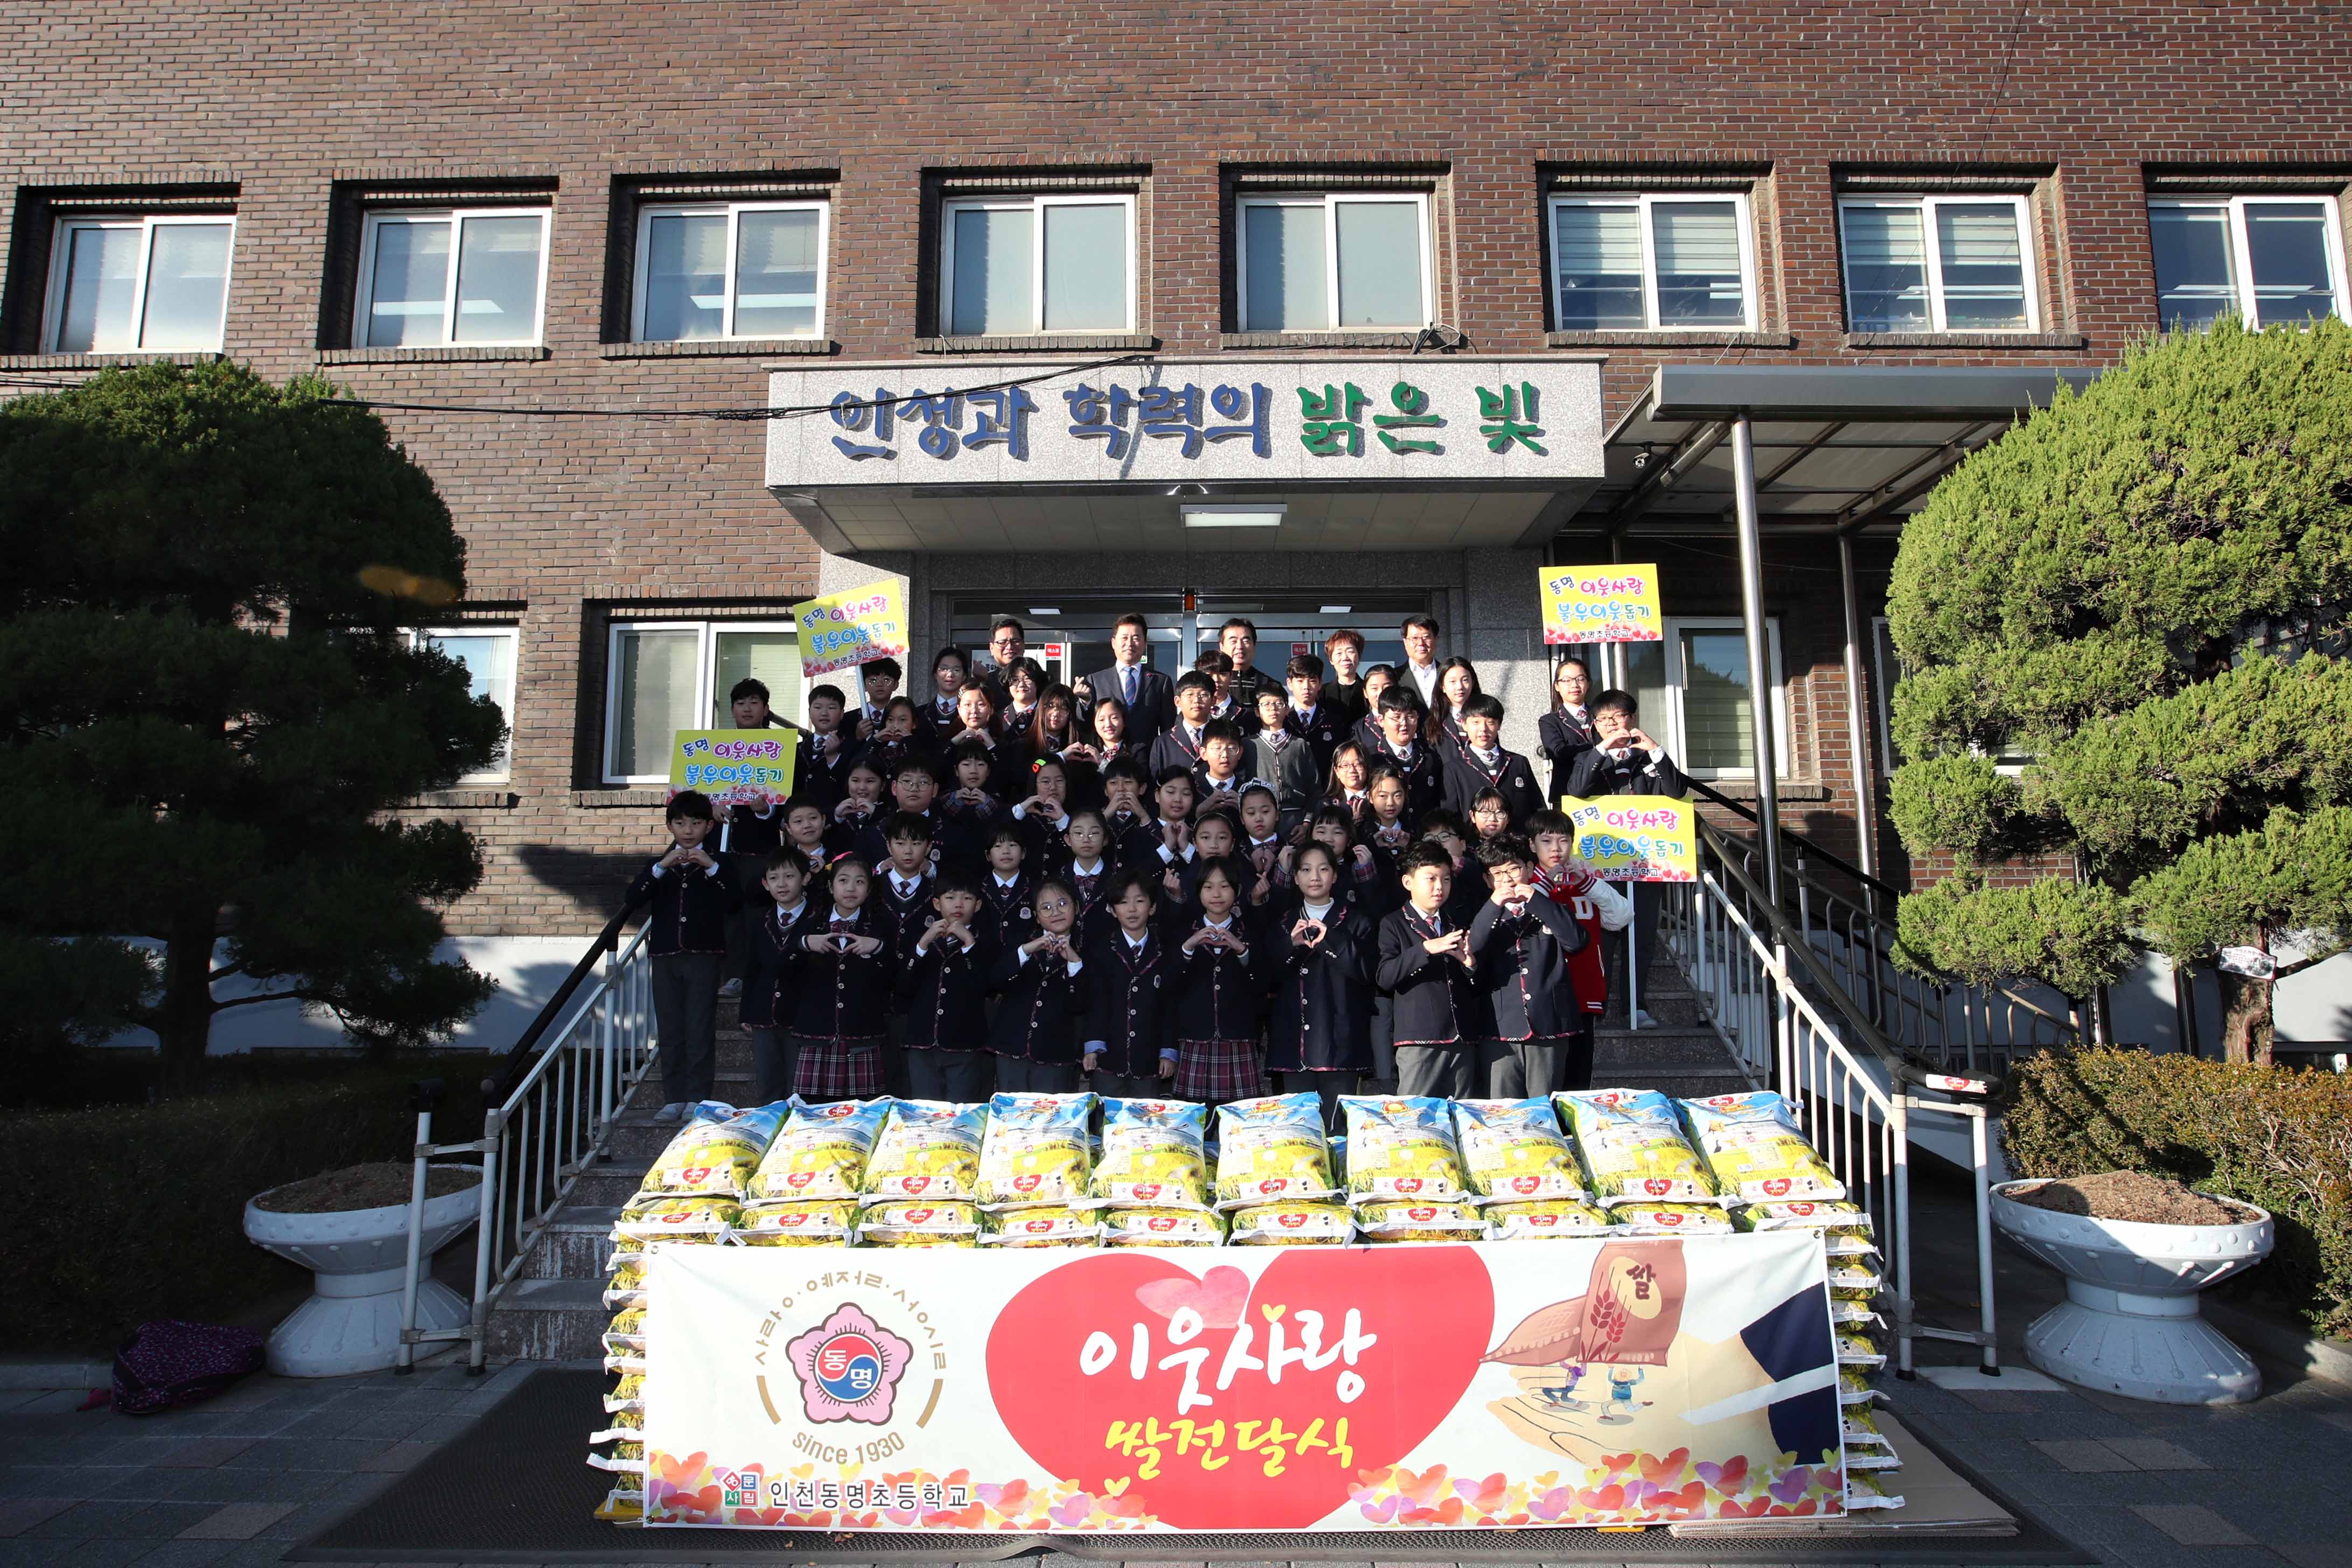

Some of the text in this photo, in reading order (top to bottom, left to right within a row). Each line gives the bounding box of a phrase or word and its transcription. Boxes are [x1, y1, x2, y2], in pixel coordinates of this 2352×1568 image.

[829, 381, 1541, 461] 인성과 학력의 밝은 빛
[1549, 576, 1644, 597] 동명 이웃사랑
[802, 596, 887, 628] 동명 이웃사랑
[1558, 600, 1650, 622] 불우이웃돕기
[812, 621, 895, 654] 불우이웃돕기
[1580, 629, 1629, 639] 동명초등학교
[833, 648, 879, 667] 동명초등학교
[682, 738, 782, 760] 동명 이웃사랑
[685, 765, 783, 785] 불우이웃돕기
[1572, 807, 1677, 830] 동명 이웃사랑
[1579, 836, 1684, 858] 불우이웃돕기
[1602, 867, 1658, 877] 동명초등학교
[1571, 896, 1594, 920] D
[1626, 1263, 1656, 1300] 쌀
[1080, 1306, 1377, 1415] 이웃사랑
[793, 1431, 906, 1465] since 1930
[1105, 1417, 1353, 1481] 쌀전달식
[770, 1481, 969, 1509] 인천동명초등학교
